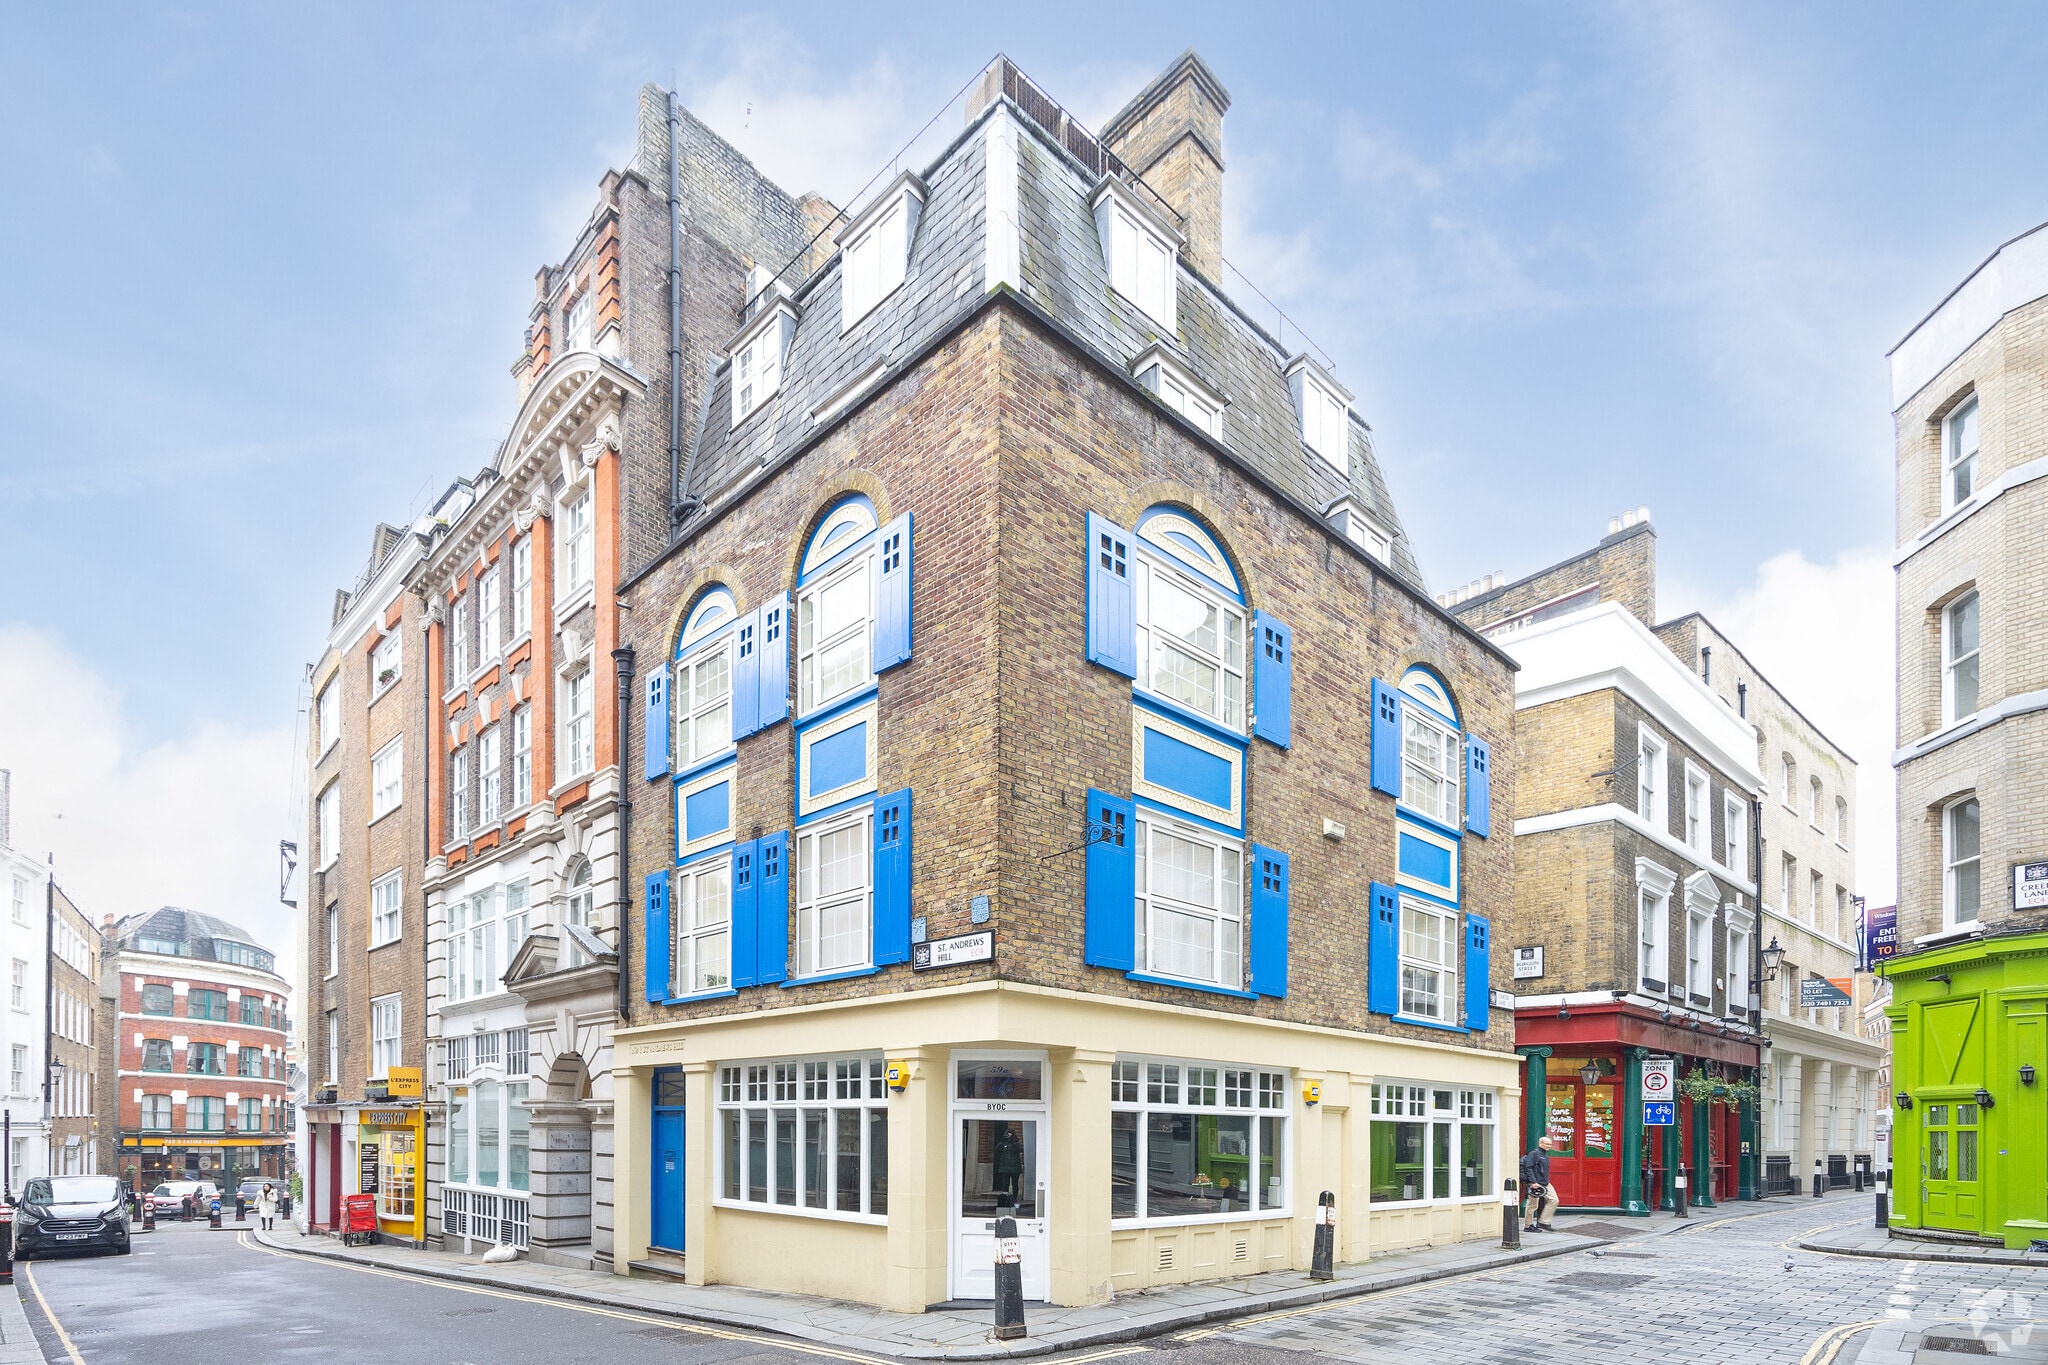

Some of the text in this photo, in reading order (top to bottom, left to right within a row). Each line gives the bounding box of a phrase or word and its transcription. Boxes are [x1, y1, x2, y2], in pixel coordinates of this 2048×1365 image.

[2021, 882, 2048, 892] CREE
[938, 938, 984, 952] ST. ANDREWS
[970, 948, 984, 958] EC4
[1878, 946, 1892, 955] TO
[938, 953, 952, 962] HILL
[395, 1112, 408, 1124] CITY
